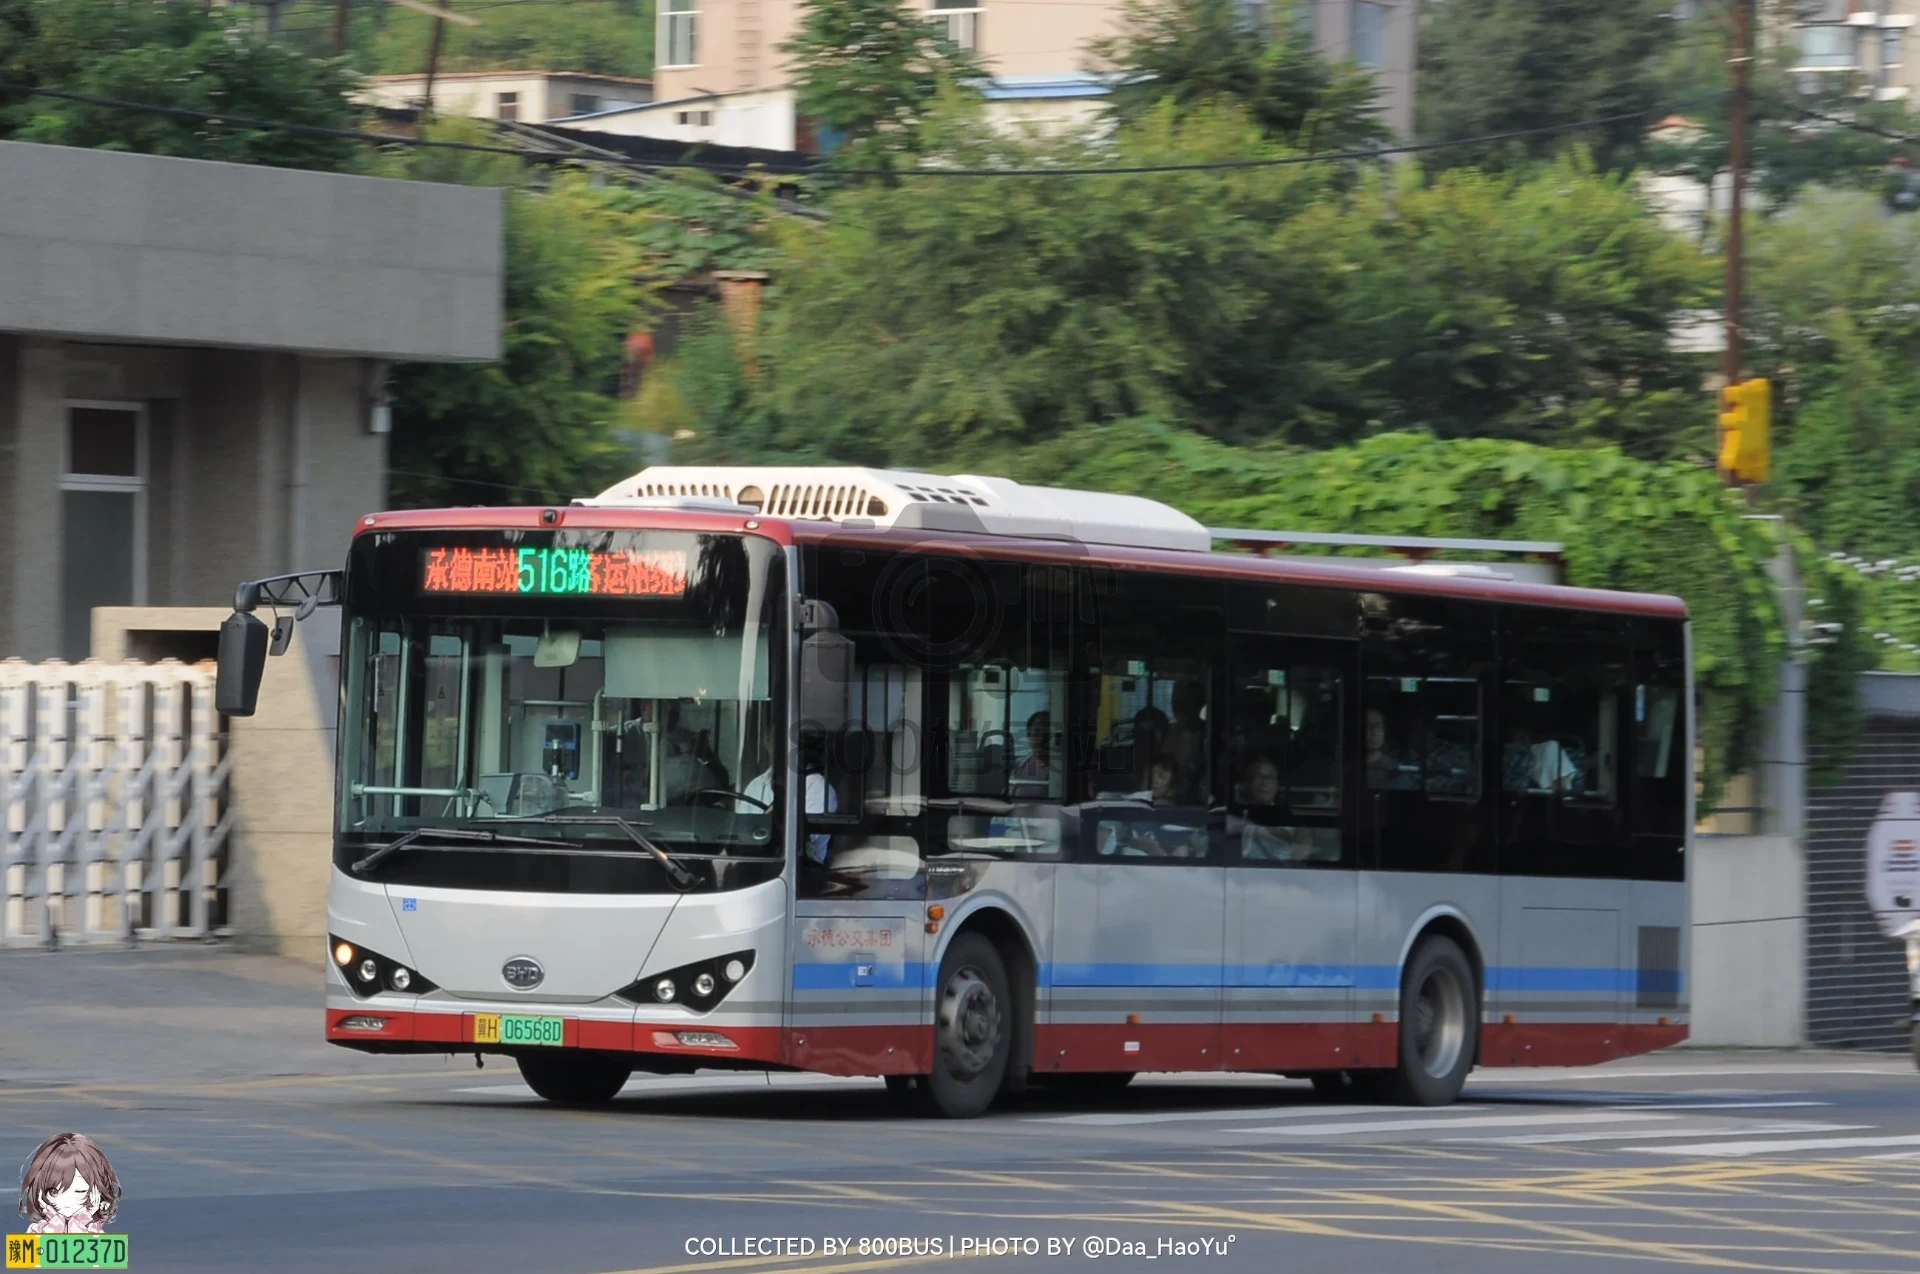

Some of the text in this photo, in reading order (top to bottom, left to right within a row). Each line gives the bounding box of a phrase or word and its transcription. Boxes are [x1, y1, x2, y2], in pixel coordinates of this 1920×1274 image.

[424, 547, 518, 592] 承德南站
[518, 547, 590, 593] 516路
[807, 928, 892, 948] 承德公交集团
[506, 966, 538, 980] BYD
[504, 1018, 562, 1042] 06568D
